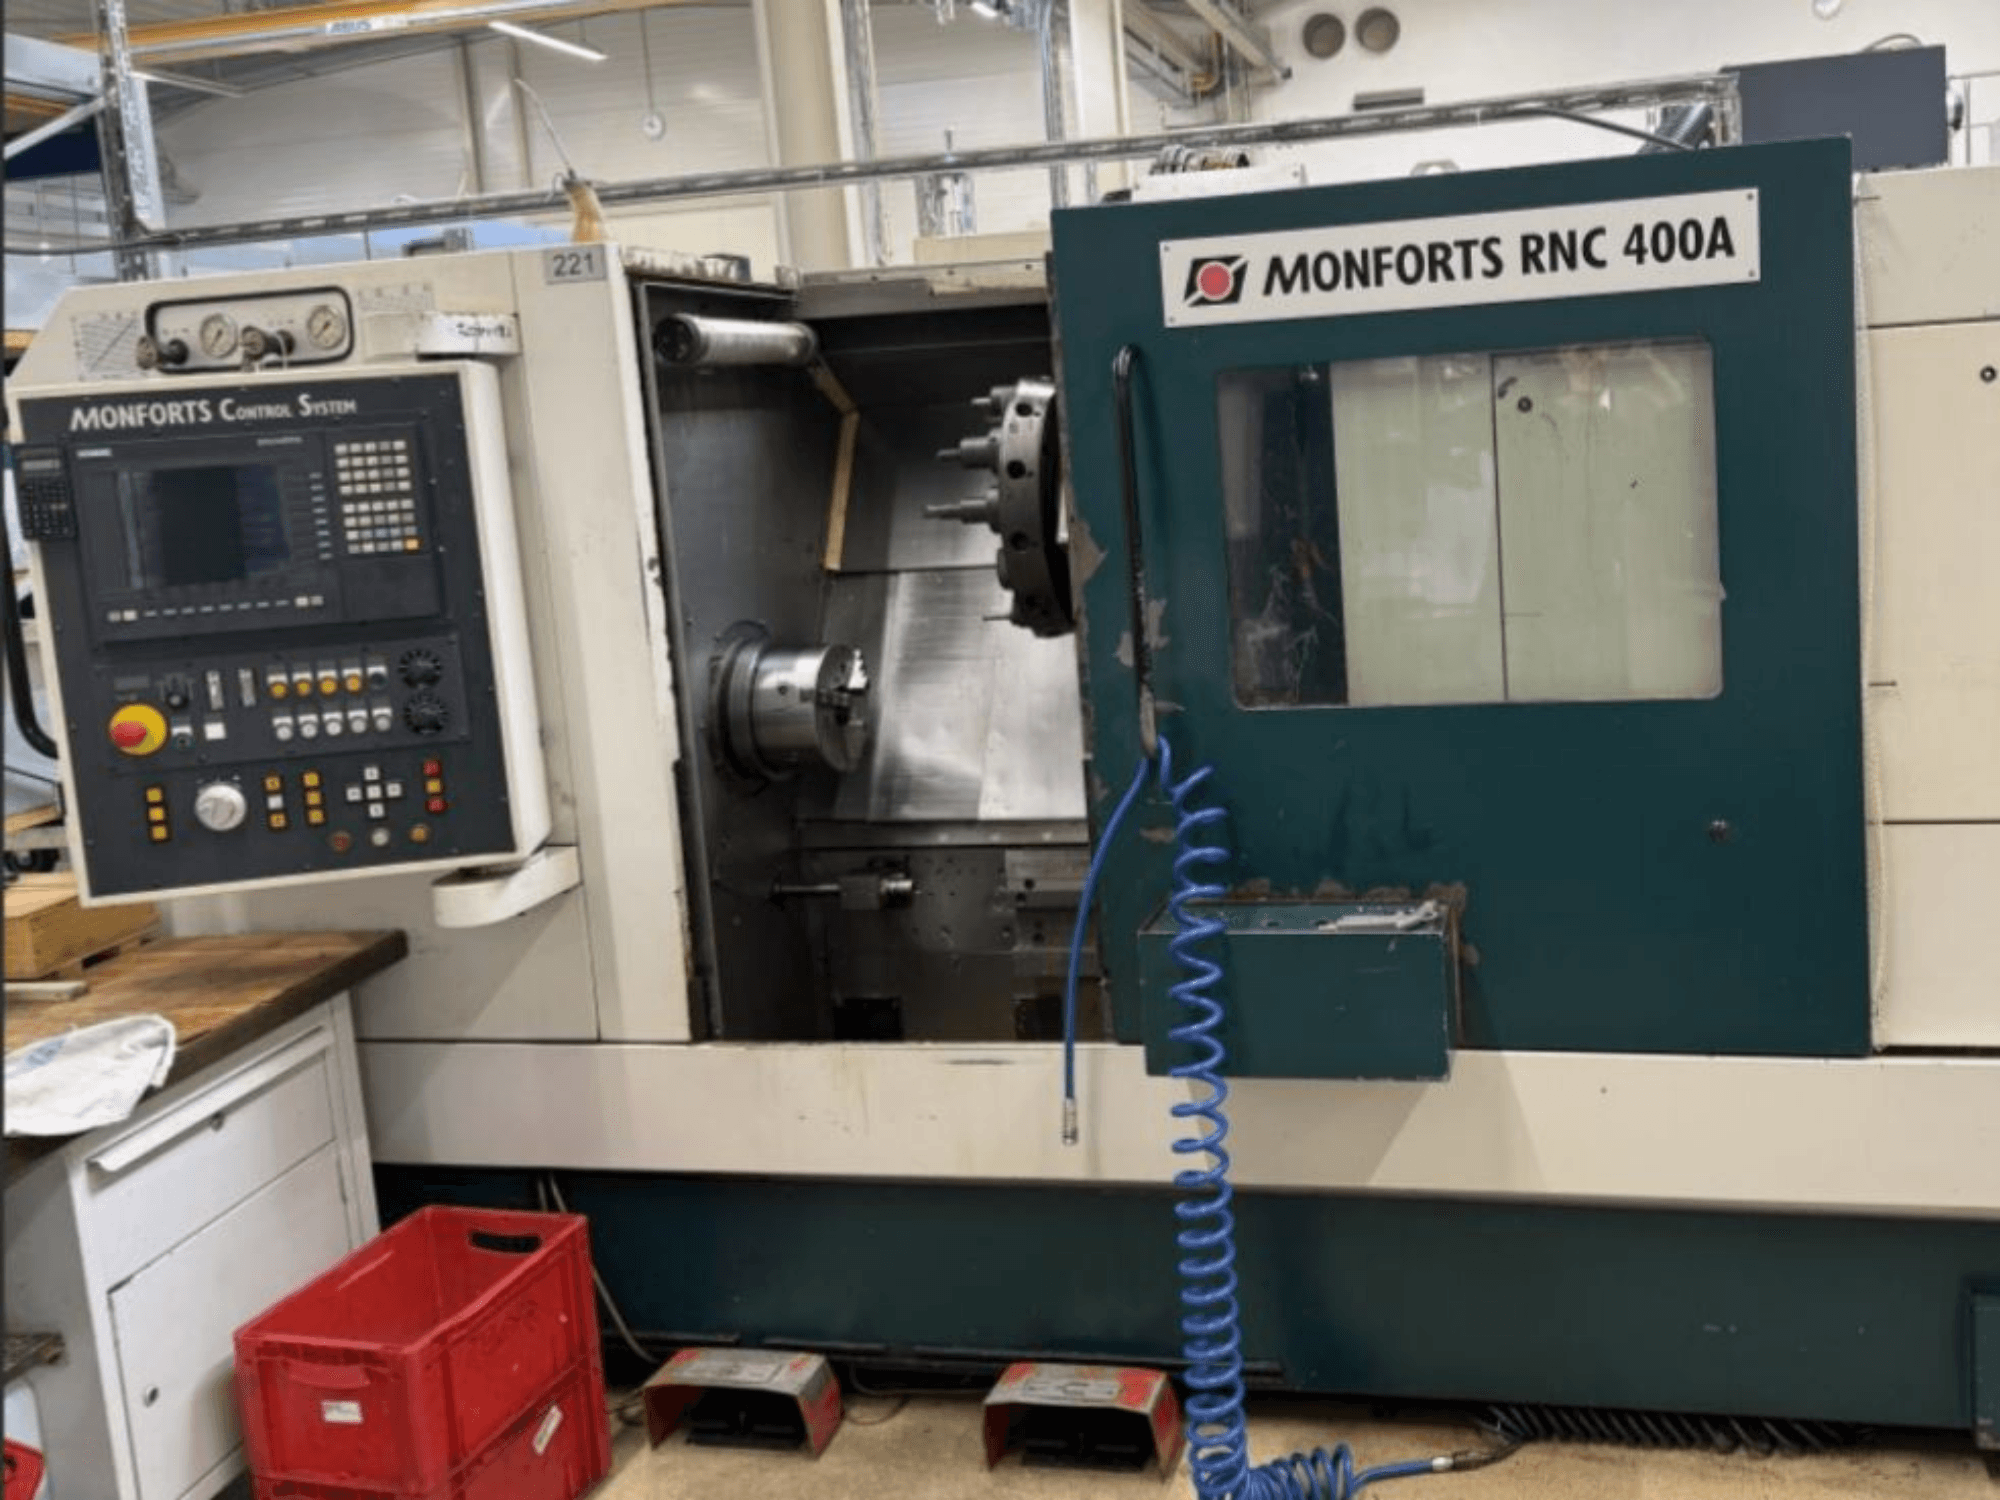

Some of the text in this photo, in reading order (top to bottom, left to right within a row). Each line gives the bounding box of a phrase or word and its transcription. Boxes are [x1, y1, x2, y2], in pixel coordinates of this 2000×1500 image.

[553, 252, 594, 278] 221
[1262, 215, 1736, 297] MONFORTS RNC 400A
[69, 398, 213, 432] MONFORTS
